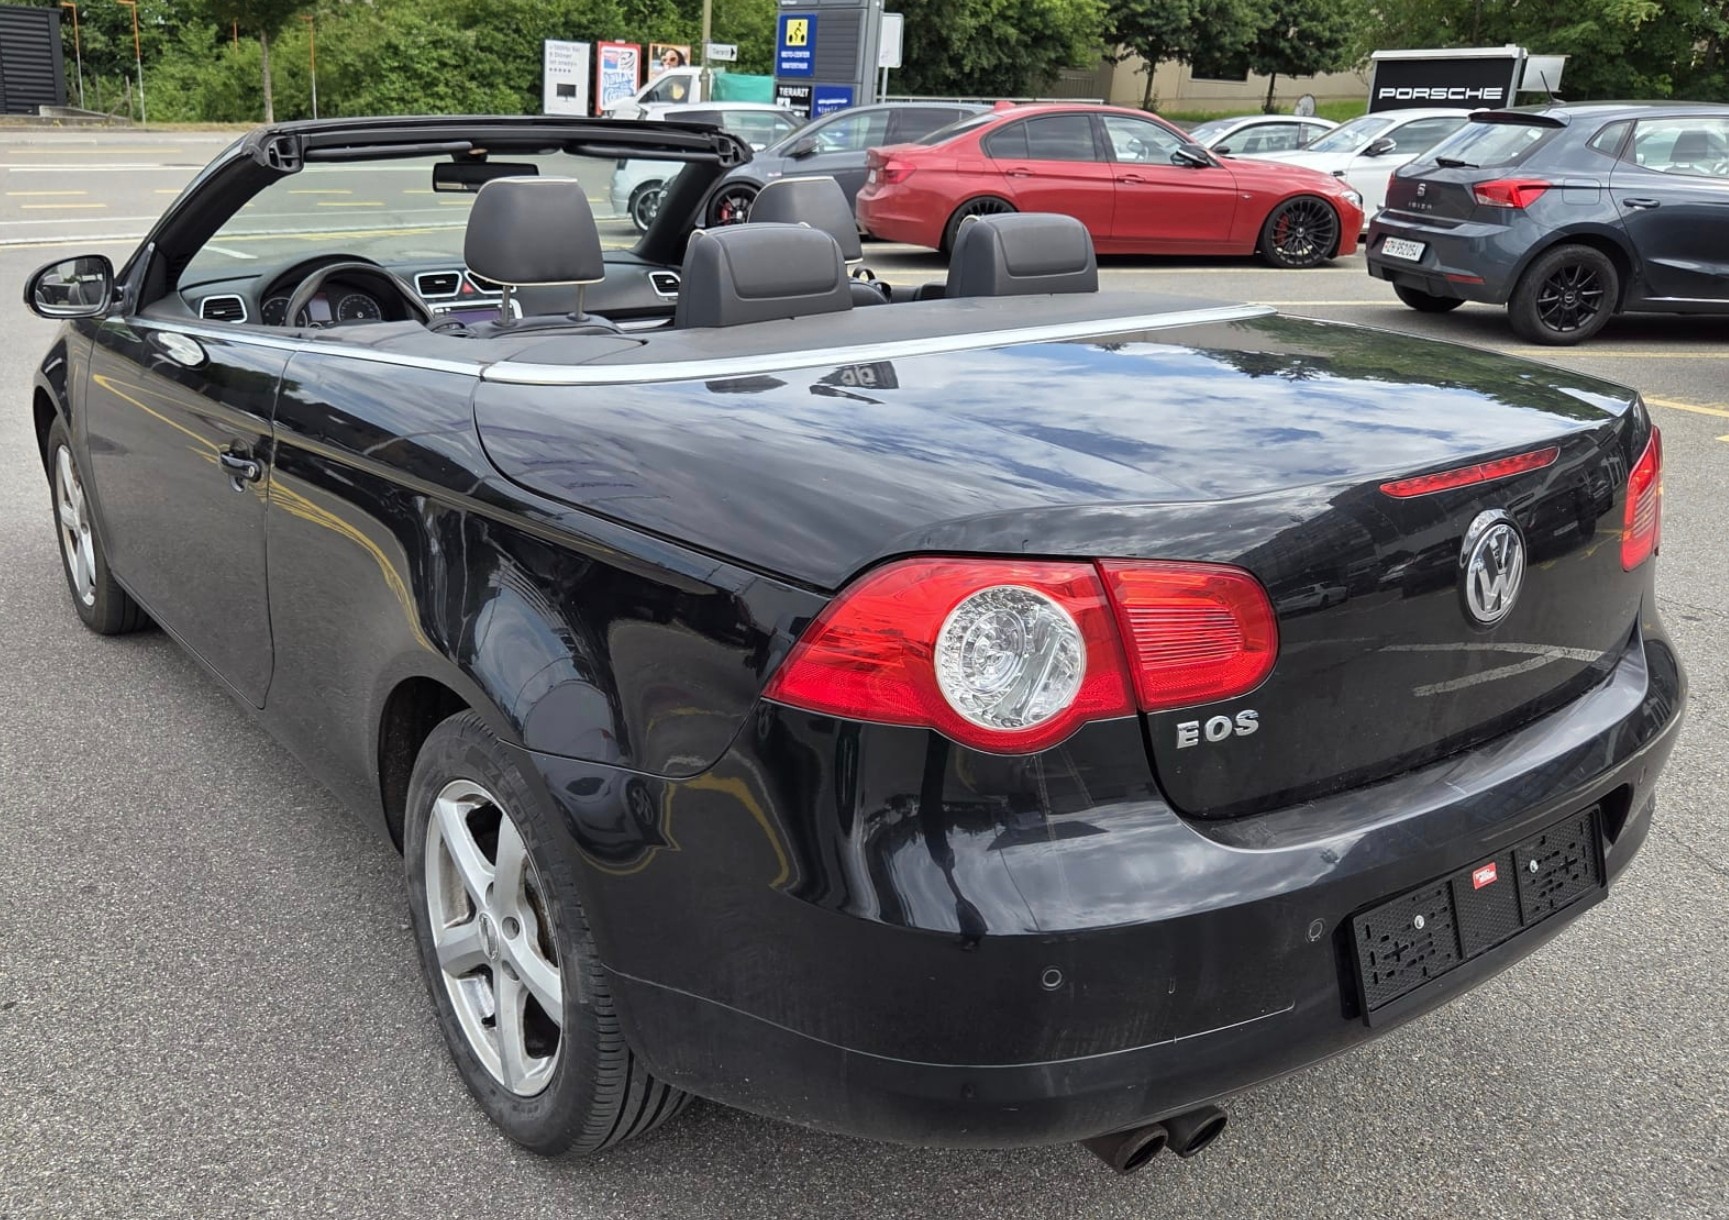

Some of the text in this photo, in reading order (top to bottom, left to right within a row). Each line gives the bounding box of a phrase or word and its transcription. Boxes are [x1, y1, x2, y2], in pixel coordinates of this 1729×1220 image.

[778, 86, 810, 97] TIERARZT
[1378, 86, 1503, 100] PORSCHE
[1176, 709, 1260, 749] EOS
